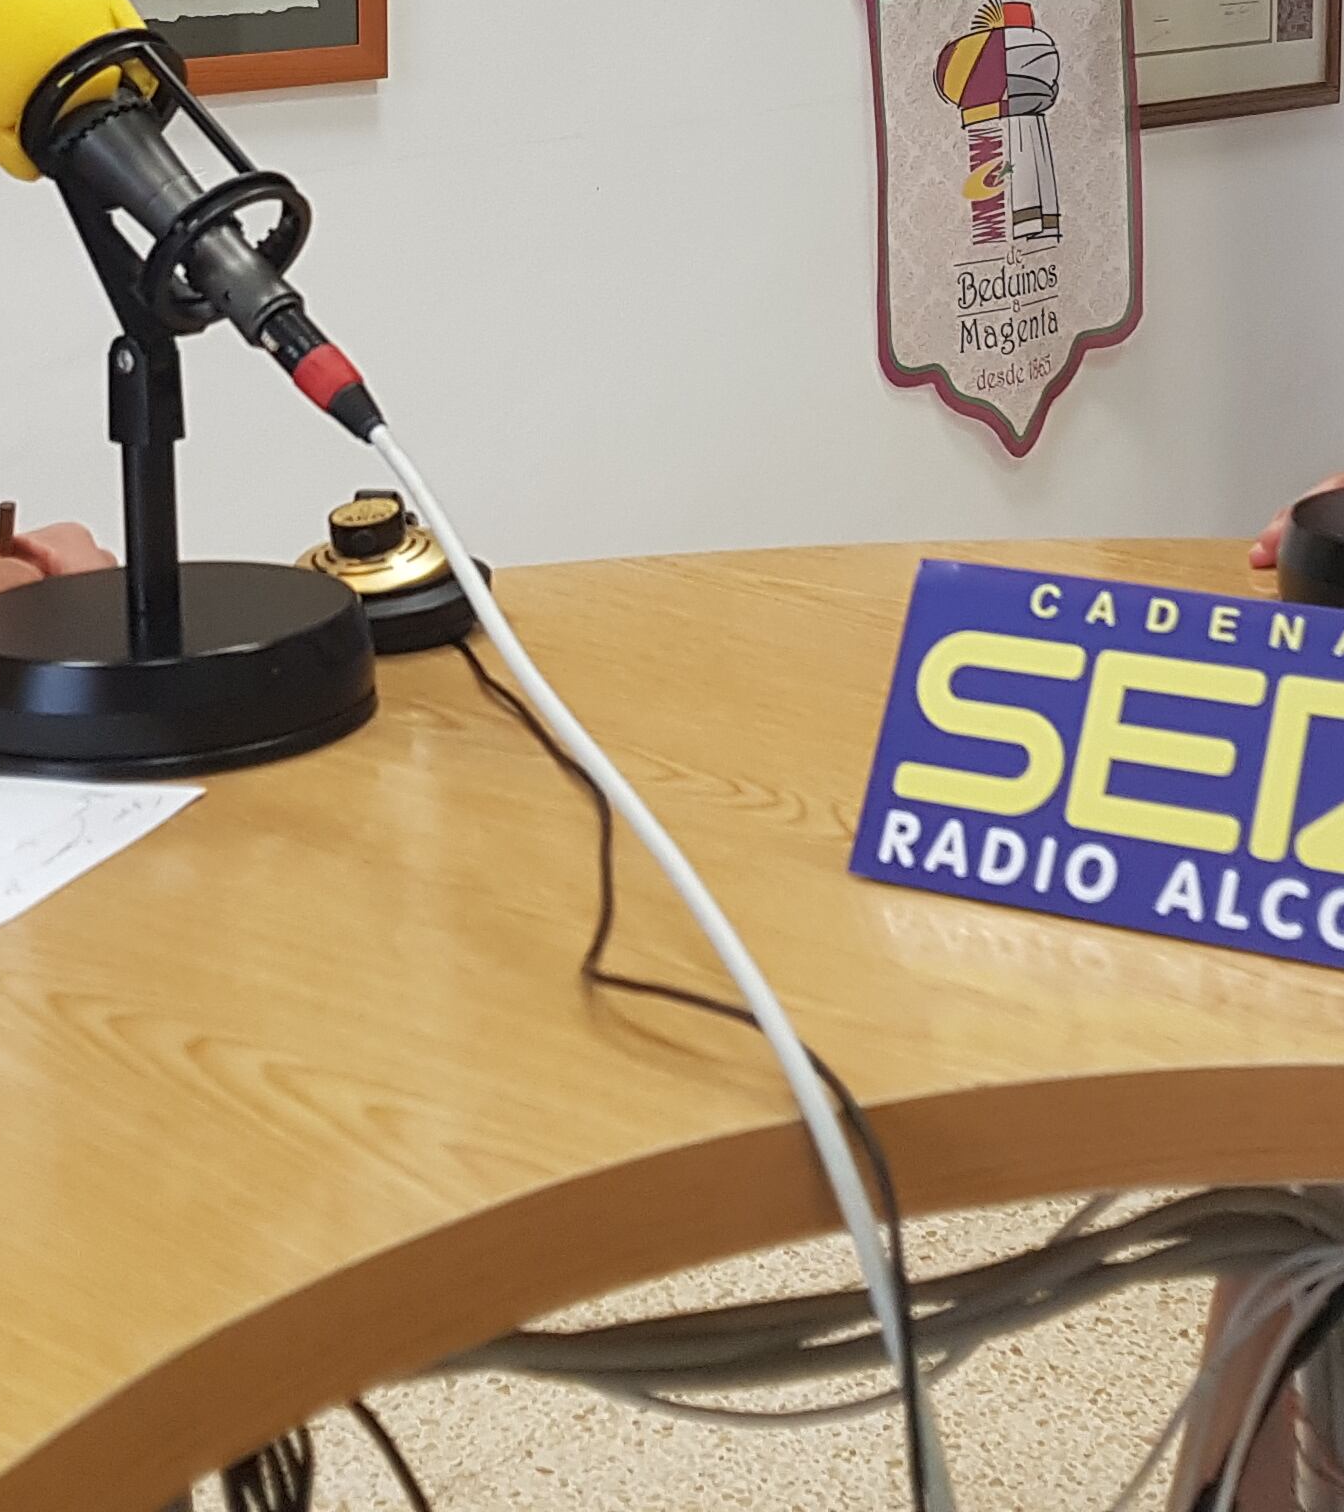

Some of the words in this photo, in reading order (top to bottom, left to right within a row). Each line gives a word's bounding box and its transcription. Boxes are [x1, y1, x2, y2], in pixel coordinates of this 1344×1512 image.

[957, 264, 1059, 310] Beduinos
[959, 306, 1059, 356] Magenta
[976, 362, 1026, 392] desde
[877, 807, 1120, 905] RADIO
